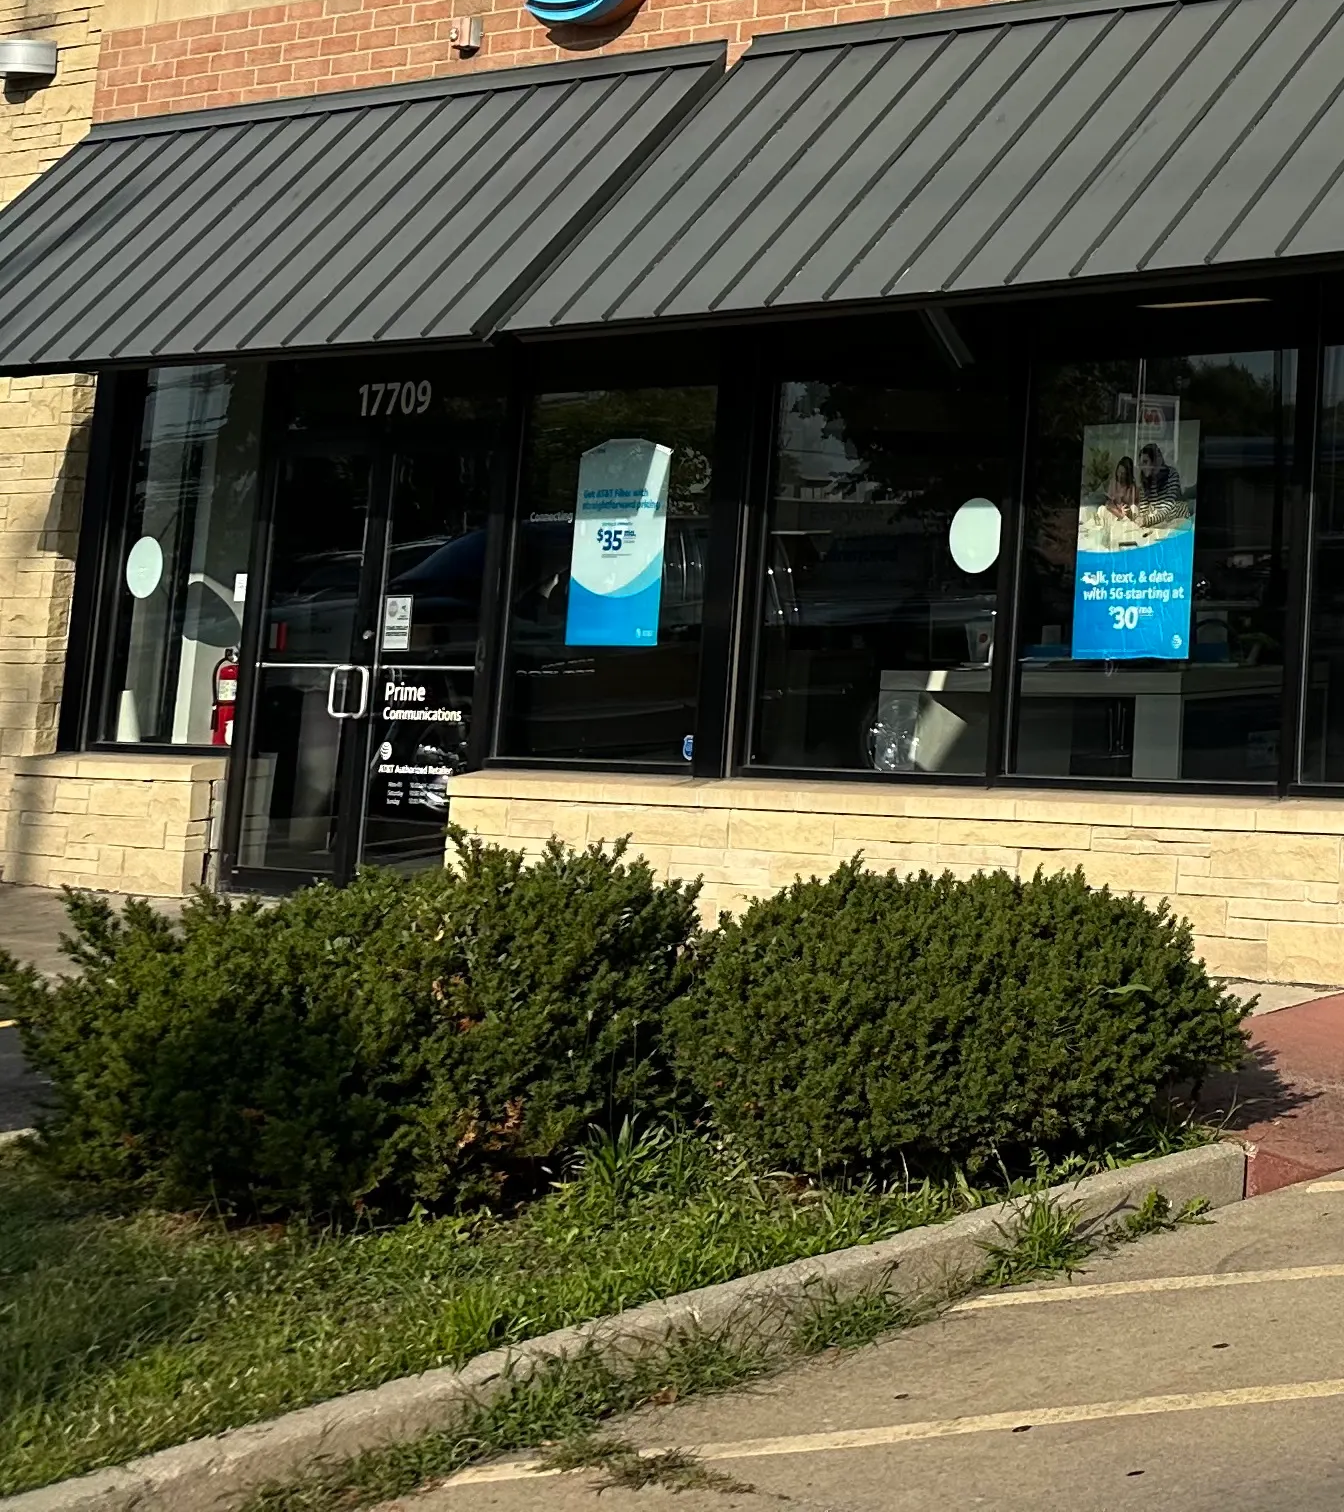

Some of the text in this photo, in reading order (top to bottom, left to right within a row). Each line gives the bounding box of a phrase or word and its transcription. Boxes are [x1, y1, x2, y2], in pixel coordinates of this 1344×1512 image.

[358, 379, 432, 417] 17709
[596, 528, 623, 552] $35
[1111, 570, 1137, 585] text,
[1138, 571, 1148, 584] &
[1149, 570, 1174, 584] data
[1083, 586, 1185, 603] with 5G starting at
[384, 681, 426, 702] Prime
[382, 706, 462, 722] Communications
